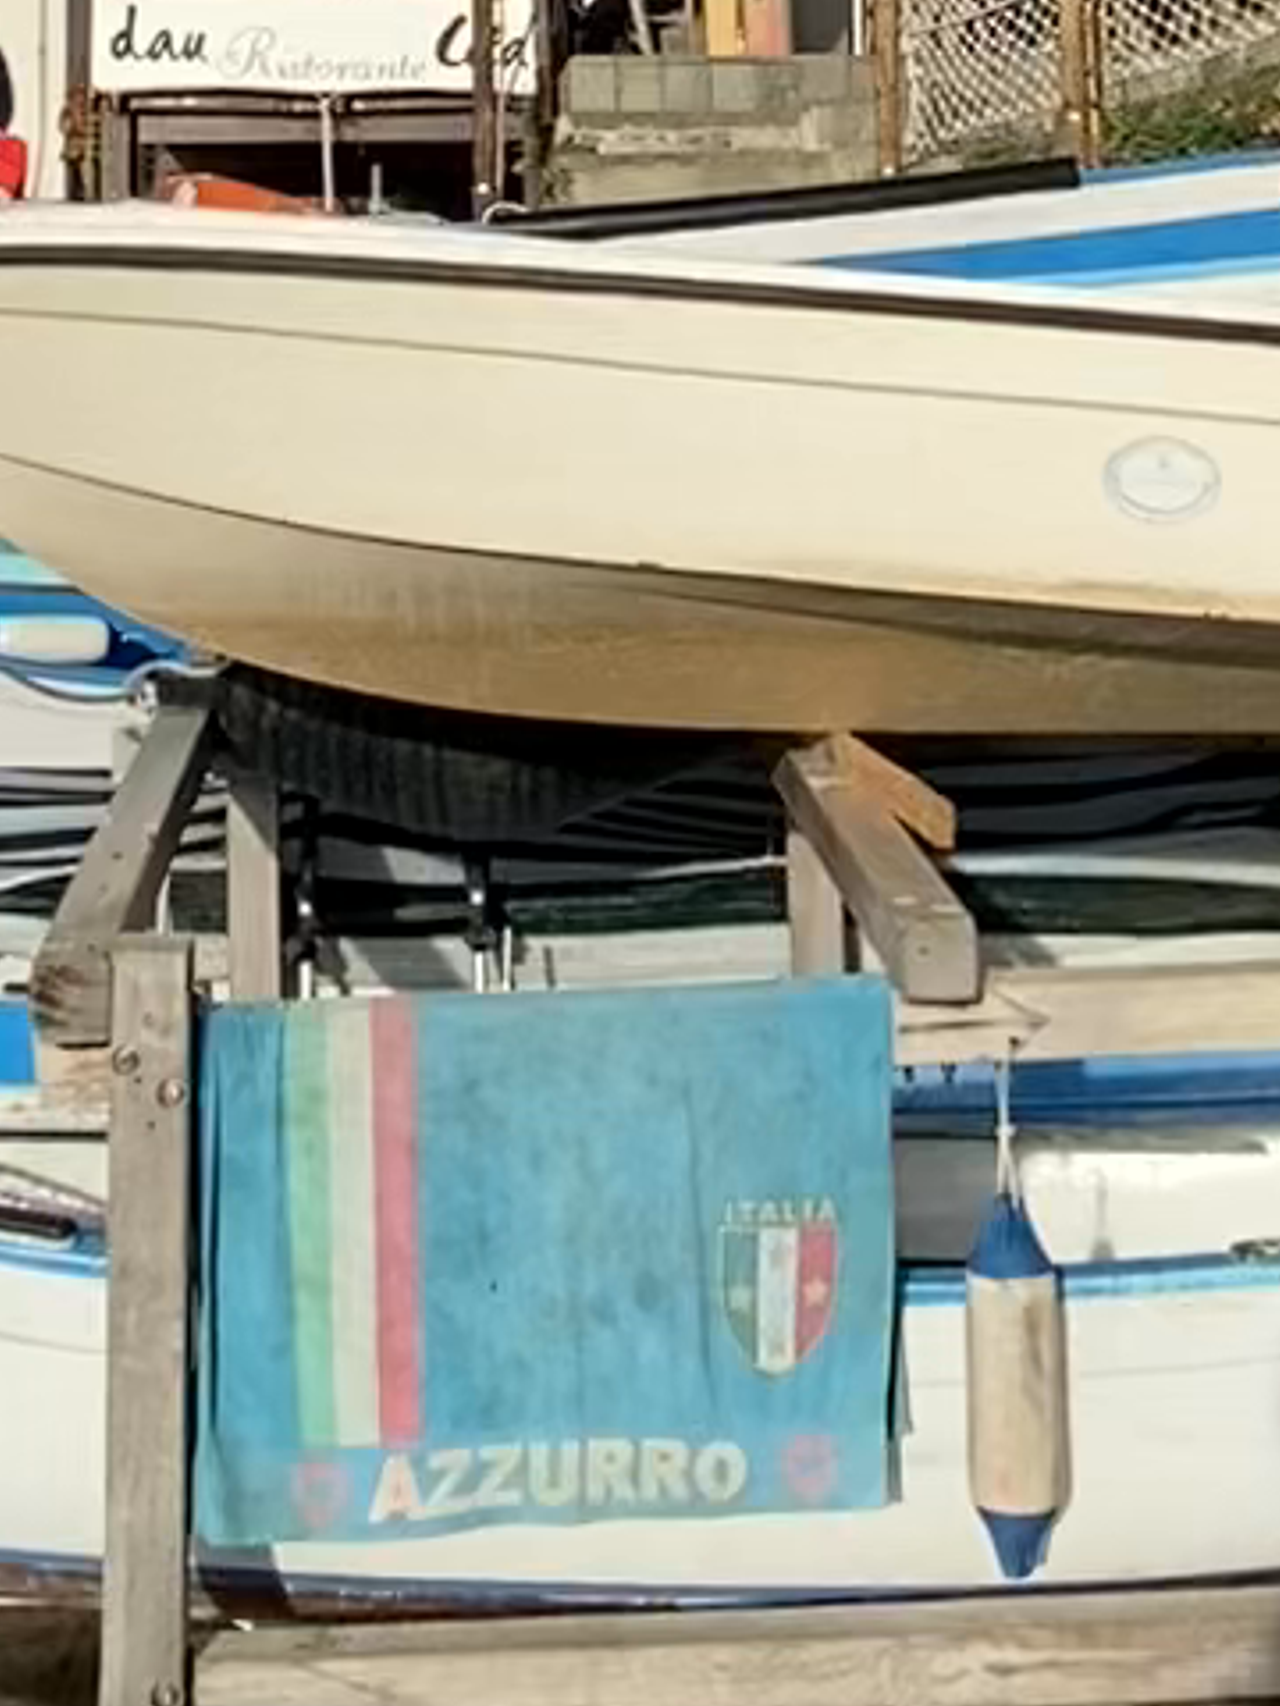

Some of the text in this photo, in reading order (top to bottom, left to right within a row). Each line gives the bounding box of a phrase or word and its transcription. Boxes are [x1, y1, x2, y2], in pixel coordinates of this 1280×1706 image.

[110, 4, 209, 64] dau
[723, 1195, 838, 1224] ITALIA
[368, 1438, 748, 1523] AZZURRO
